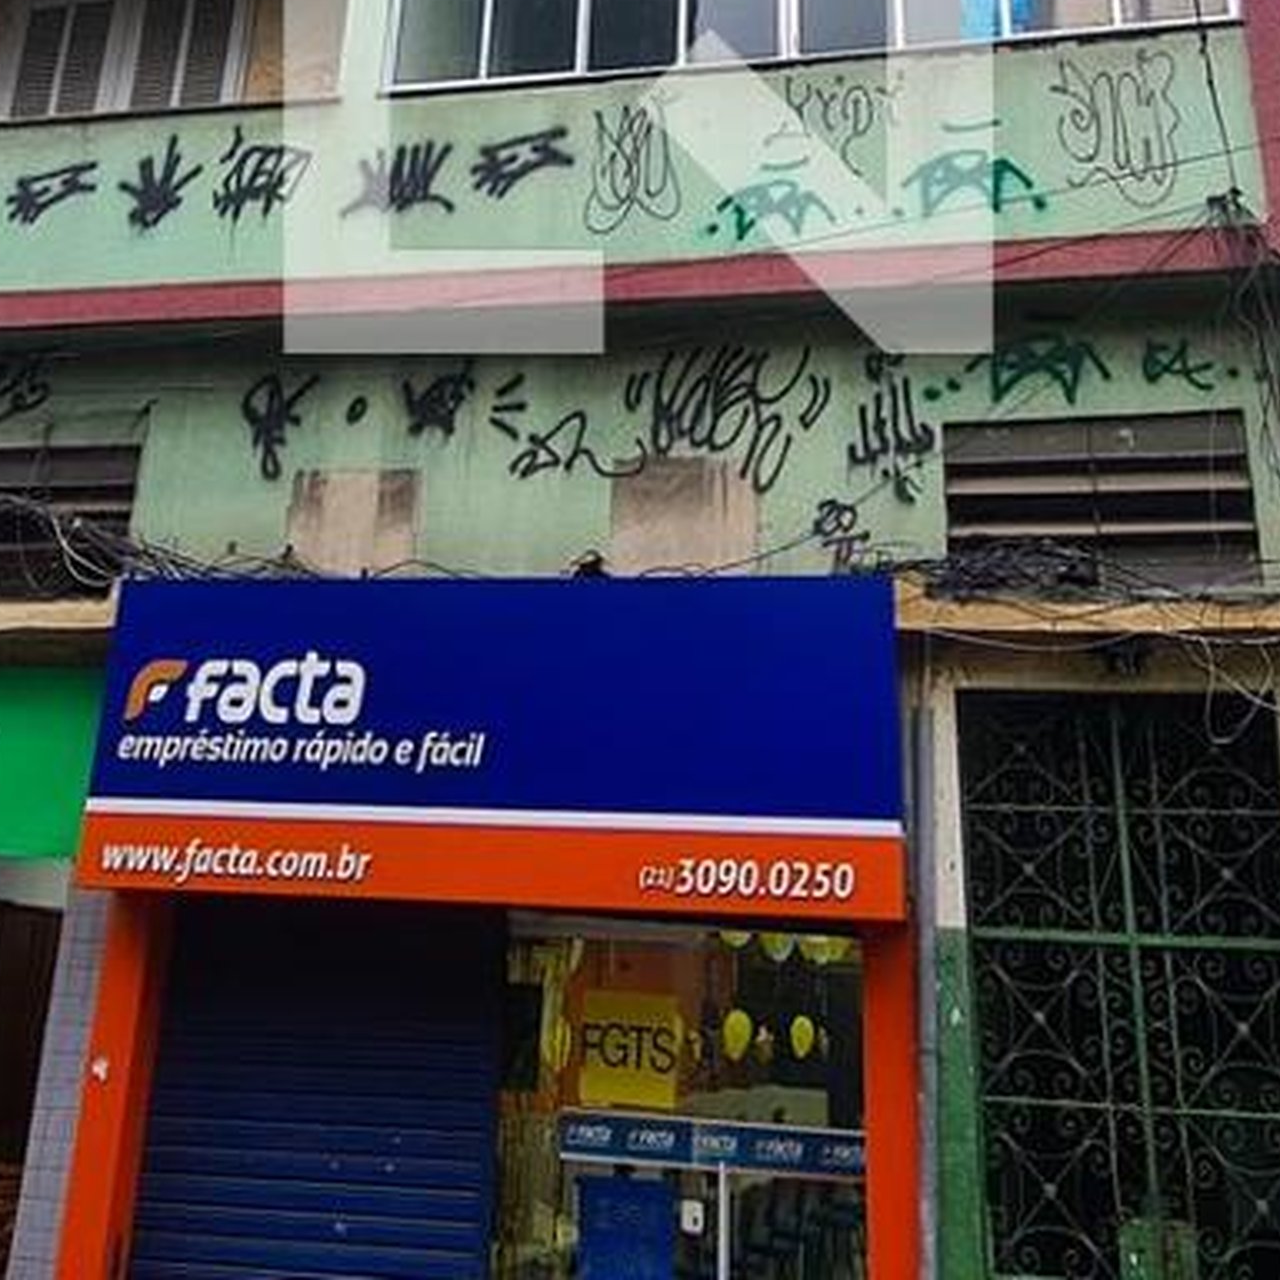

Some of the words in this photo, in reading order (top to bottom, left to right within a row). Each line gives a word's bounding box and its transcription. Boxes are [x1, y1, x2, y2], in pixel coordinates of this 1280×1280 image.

[183, 650, 367, 725] facta
[118, 728, 288, 767] empréstimo
[292, 729, 388, 770] rápido
[394, 739, 412, 766] e
[416, 730, 486, 774] fácil
[100, 838, 373, 883] www.facta.com.br
[582, 1023, 679, 1073] FGTS
